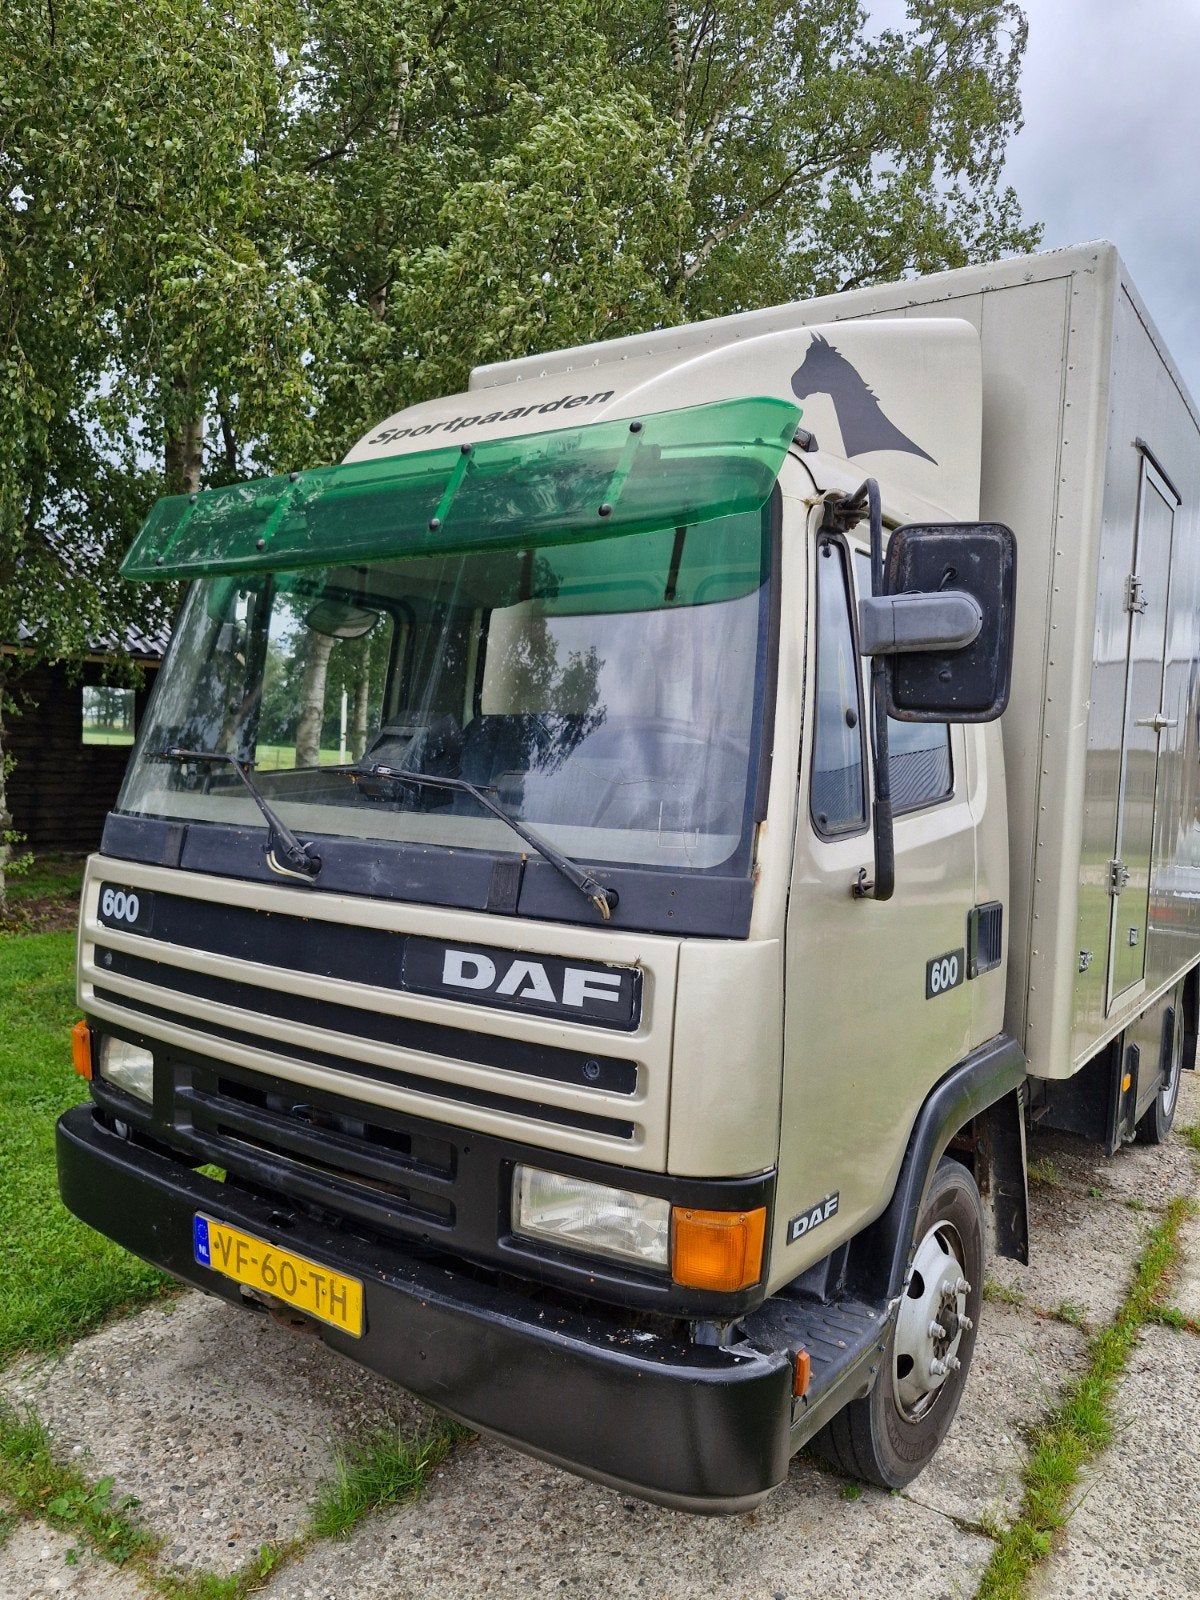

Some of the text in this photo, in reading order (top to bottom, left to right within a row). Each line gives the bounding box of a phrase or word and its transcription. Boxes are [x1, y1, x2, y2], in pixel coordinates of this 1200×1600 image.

[368, 390, 614, 445] Sportpaarden
[102, 888, 139, 922] 600
[442, 949, 621, 1007] DAF
[931, 955, 958, 993] 600
[792, 1196, 838, 1239] DAF
[198, 1243, 209, 1257] NL
[217, 1231, 347, 1321] VF-60-TH
